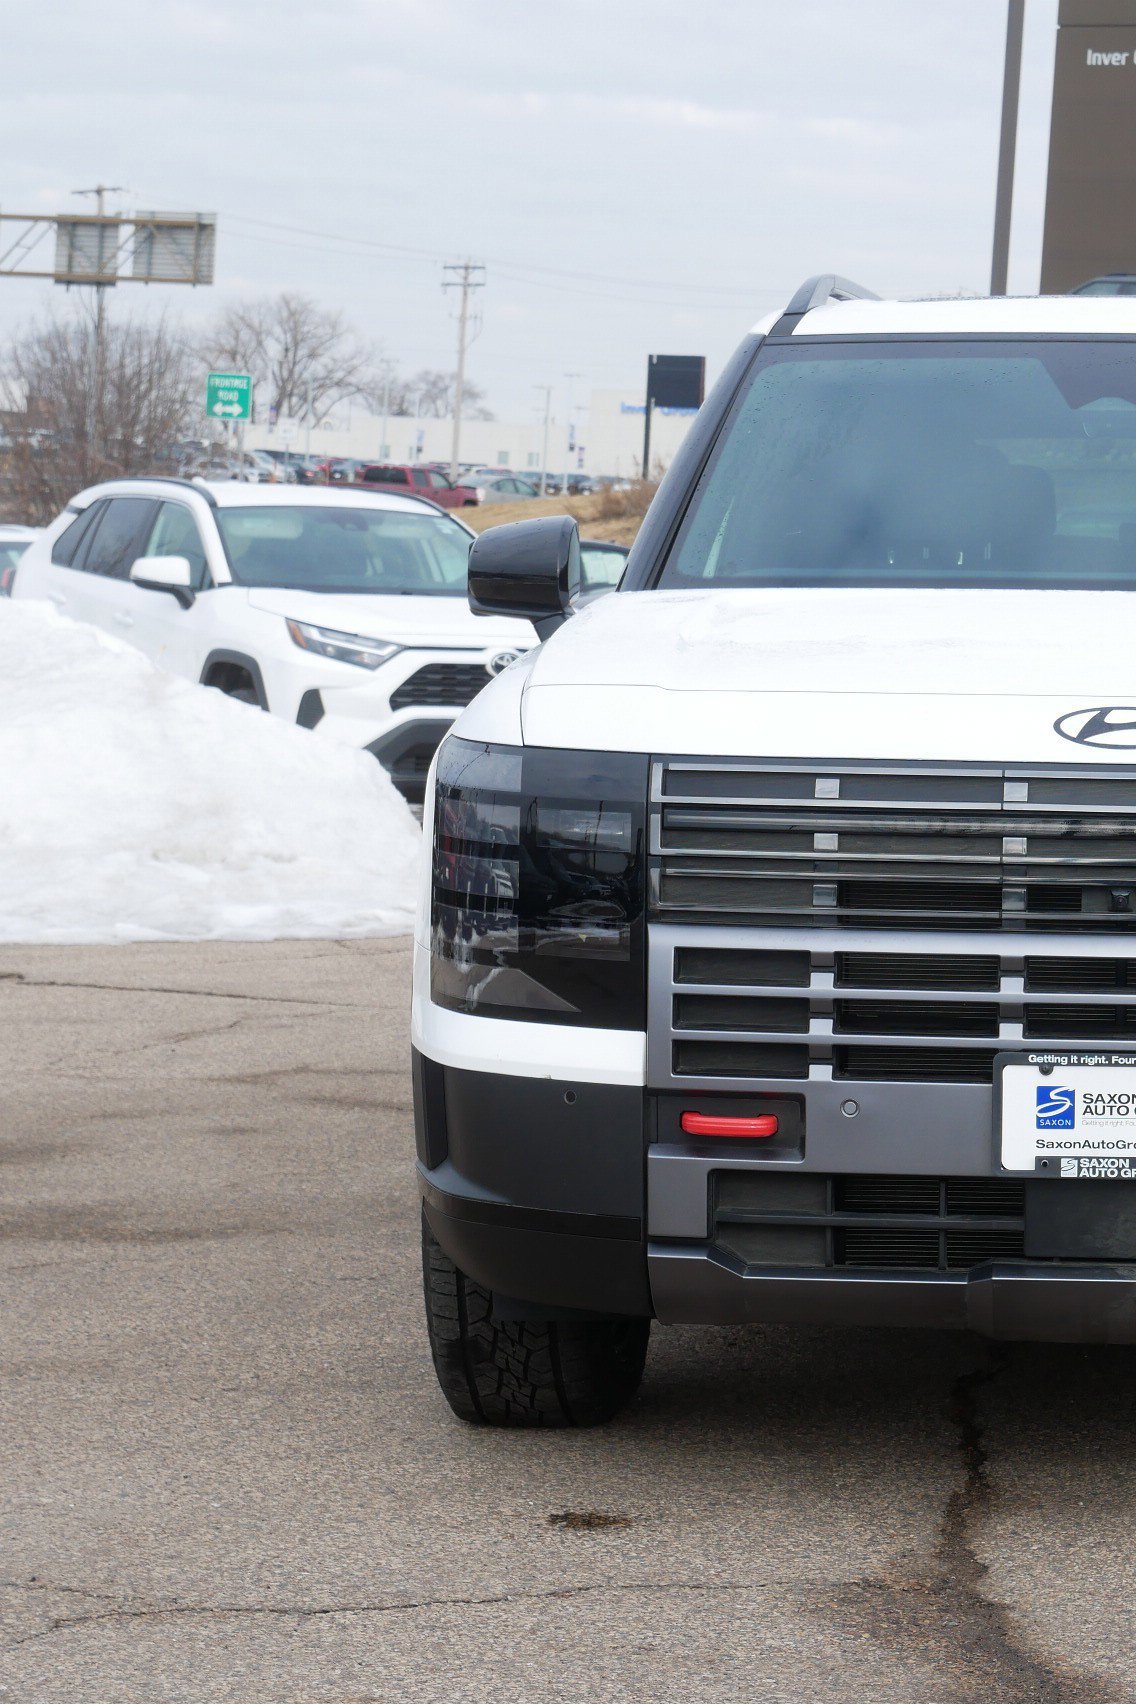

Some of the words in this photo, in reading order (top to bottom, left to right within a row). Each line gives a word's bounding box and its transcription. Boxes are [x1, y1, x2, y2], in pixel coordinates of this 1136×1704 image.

[1086, 49, 1129, 66] Inver
[1028, 1054, 1068, 1066] Getting
[1070, 1055, 1078, 1064] it
[1080, 1055, 1109, 1066] right.
[1111, 1055, 1136, 1065] Four
[1082, 1105, 1130, 1116] AUTO
[1079, 1158, 1130, 1168] SAXON
[1079, 1168, 1120, 1178] AUTO
